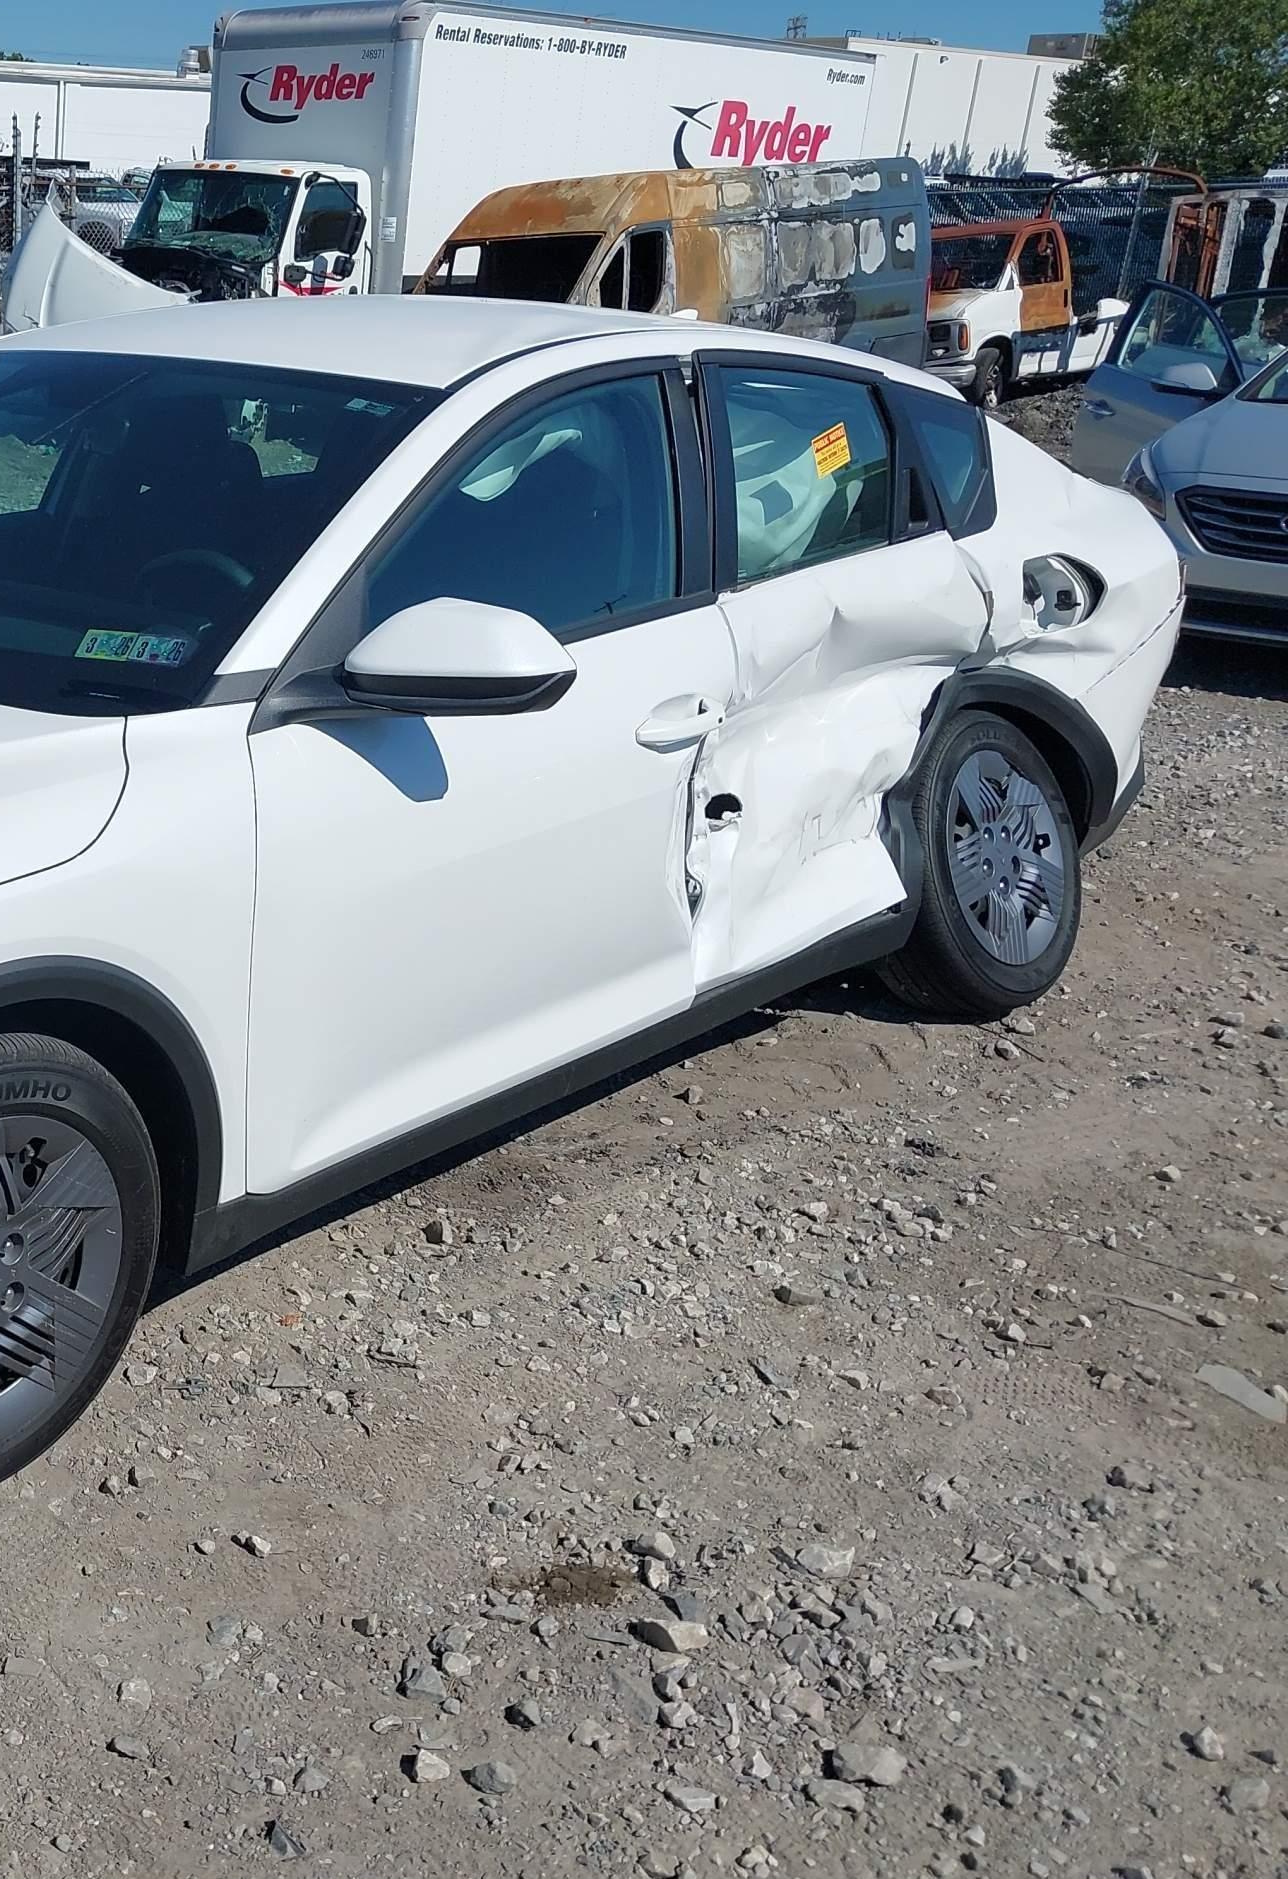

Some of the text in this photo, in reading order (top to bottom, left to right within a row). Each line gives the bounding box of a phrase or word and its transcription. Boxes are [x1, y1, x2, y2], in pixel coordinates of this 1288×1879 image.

[435, 24, 628, 59] Rental Reservations: 1-800-BY-RYDER
[269, 63, 376, 110] Ryder
[826, 68, 866, 85] Ryder.com
[710, 100, 833, 166] Ryder
[85, 636, 134, 656] 3 26
[137, 641, 187, 661] 3 26
